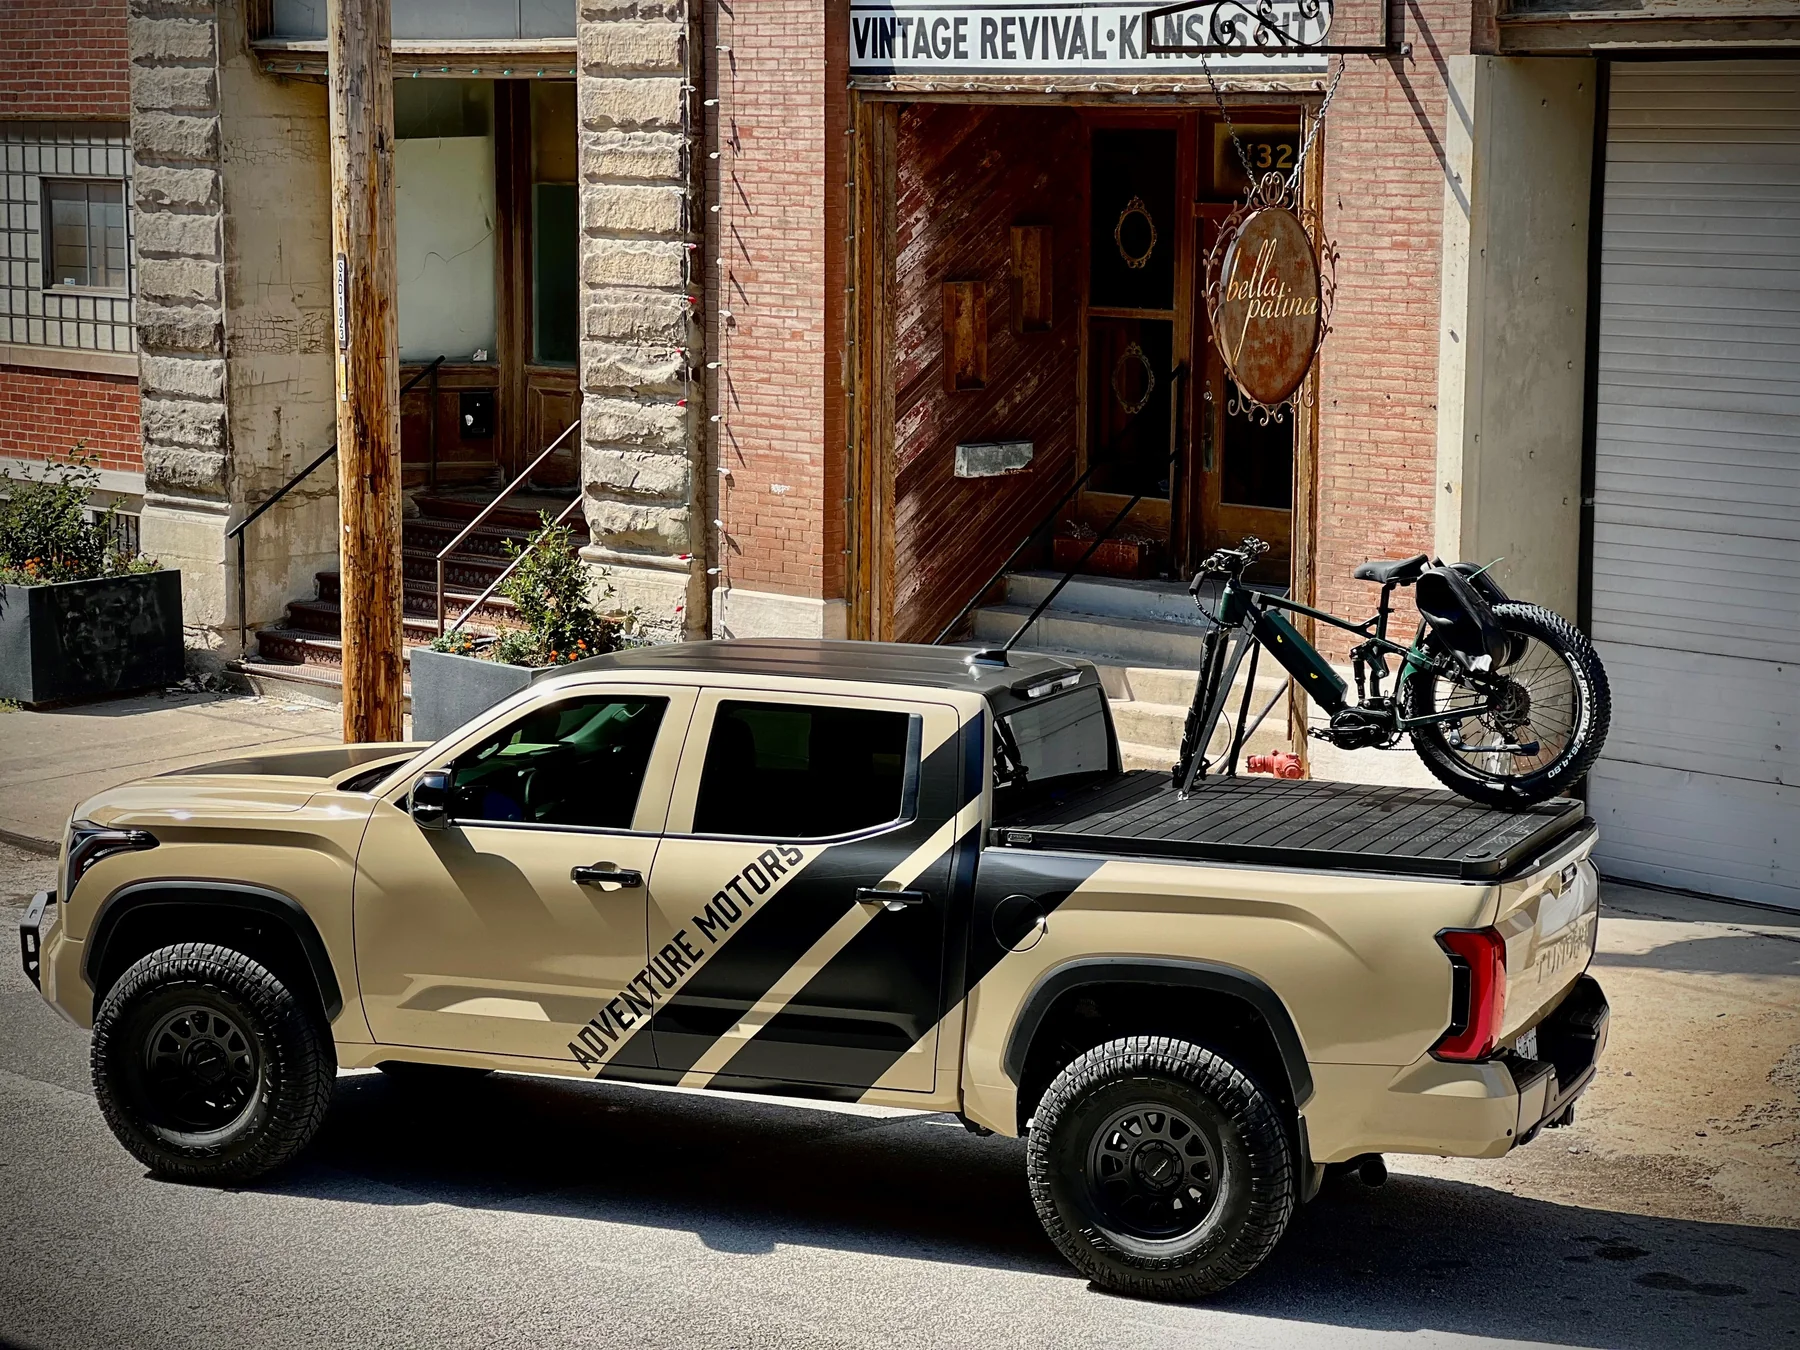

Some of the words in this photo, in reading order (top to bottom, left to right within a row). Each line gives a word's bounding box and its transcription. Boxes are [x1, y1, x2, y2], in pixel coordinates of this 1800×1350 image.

[852, 16, 968, 60] VINTAGE
[980, 15, 1107, 60] REVIVAL
[1119, 12, 1248, 60] KANSAS
[1226, 238, 1278, 302] bella
[1232, 281, 1319, 366] patina
[567, 929, 705, 1071] ADVENTURE
[691, 844, 805, 944] MOTORS
